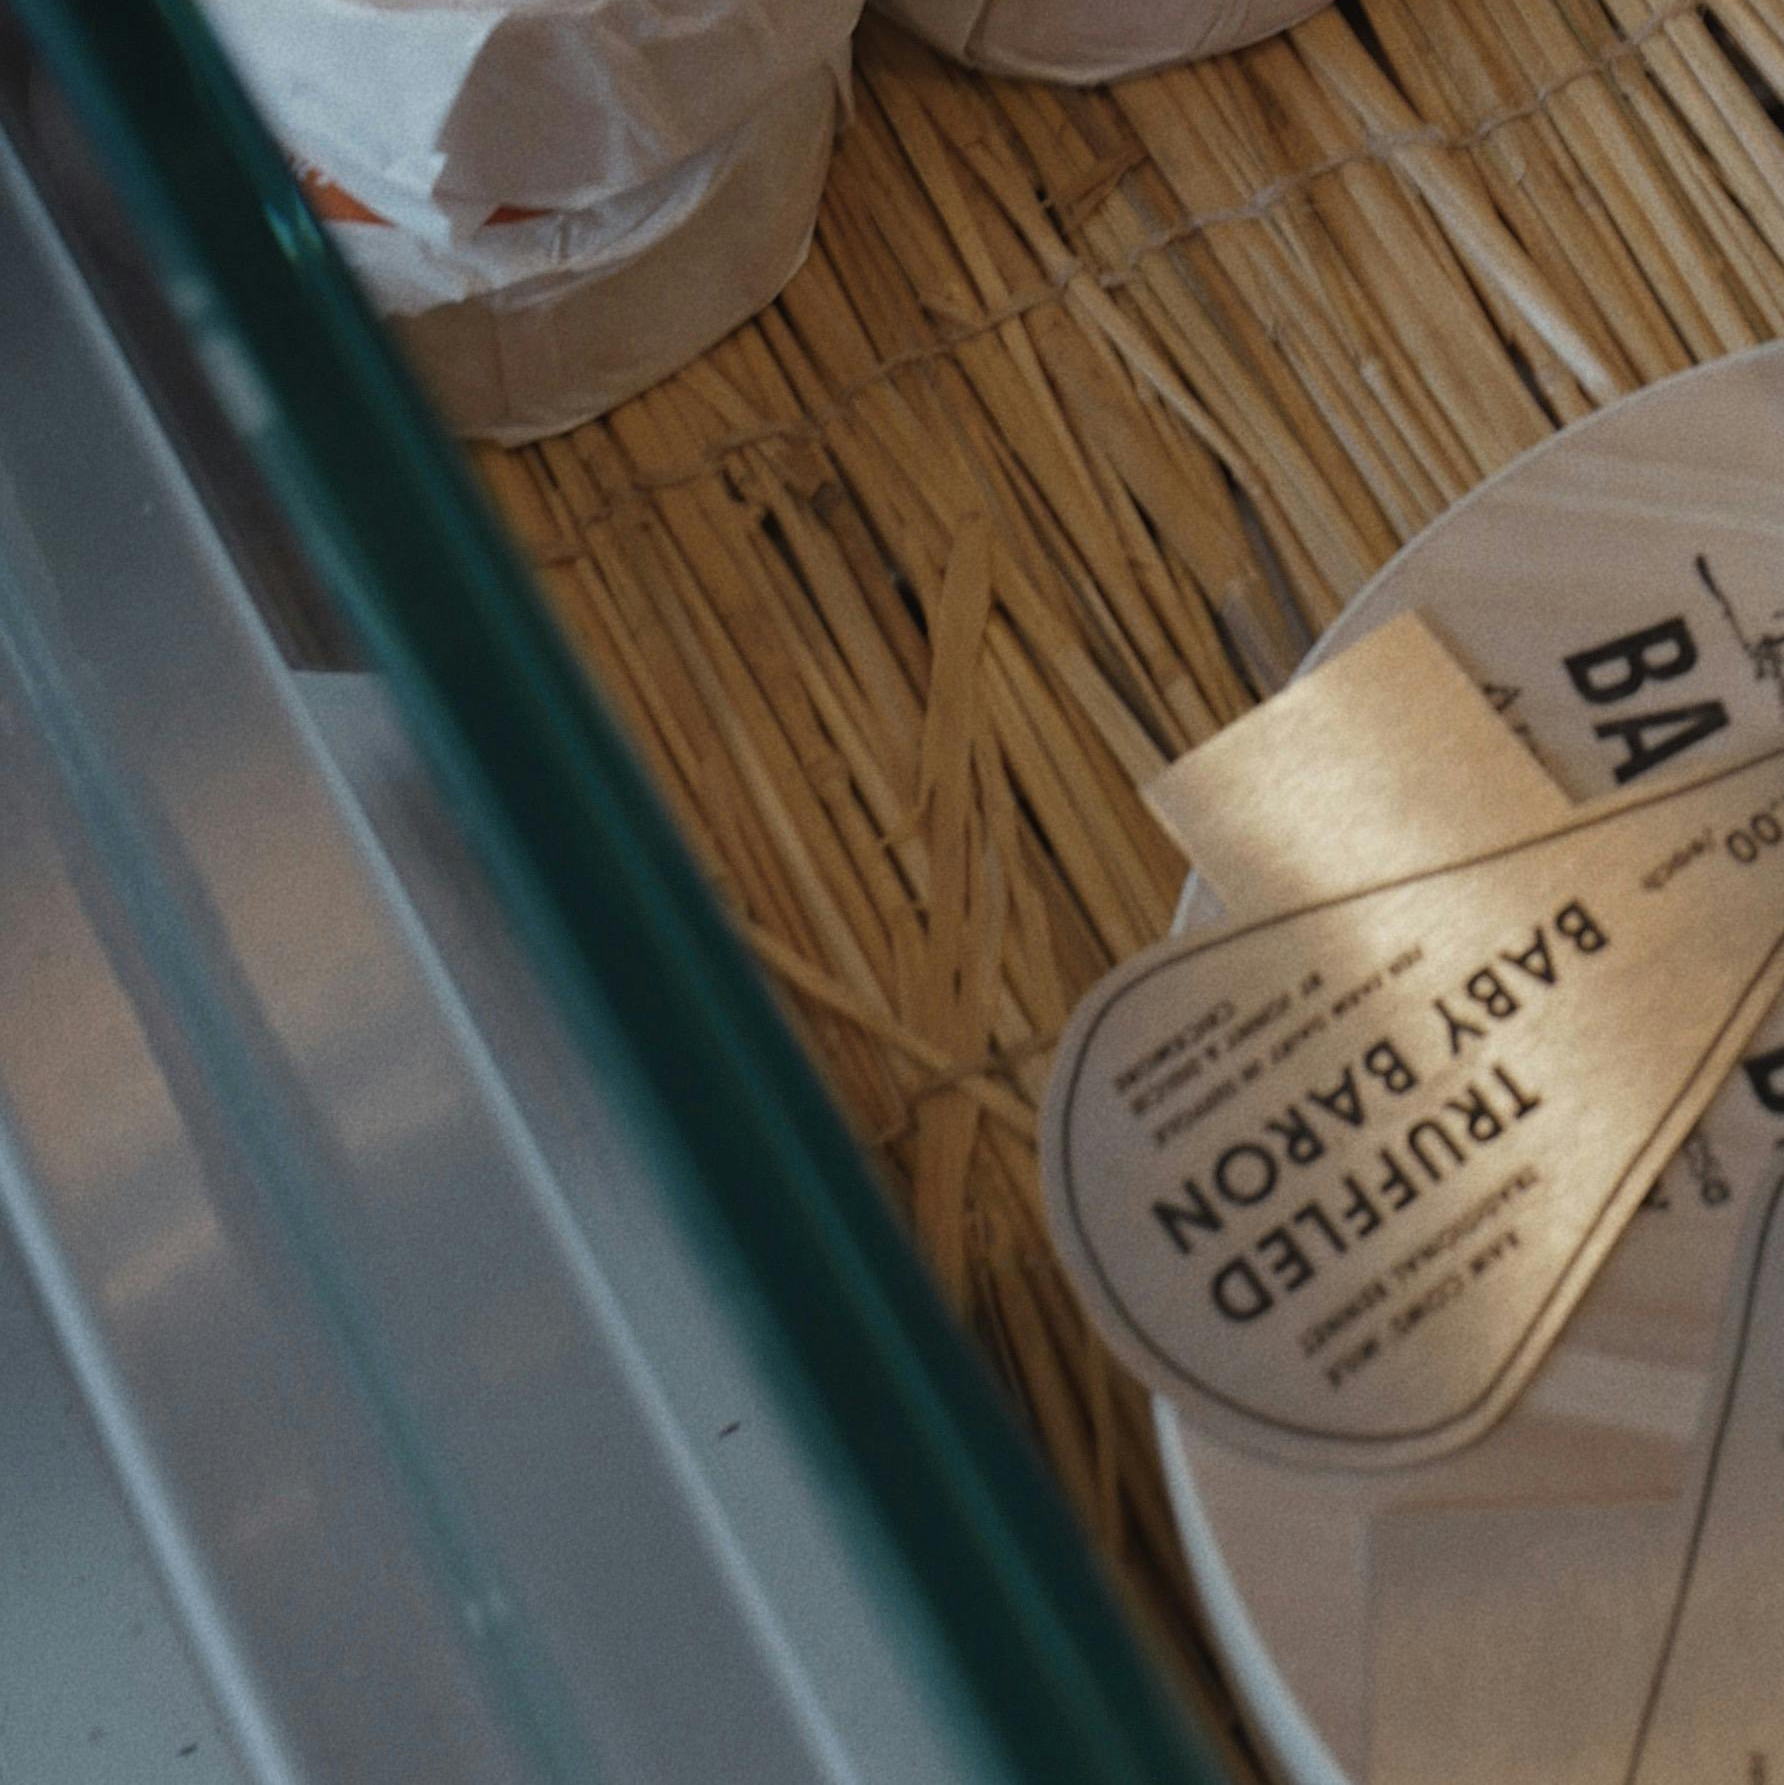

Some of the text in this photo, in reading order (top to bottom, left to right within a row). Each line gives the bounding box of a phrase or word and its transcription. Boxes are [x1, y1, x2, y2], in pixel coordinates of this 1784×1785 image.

[1150, 898, 1612, 1257] BABY BARON
[1209, 1059, 1543, 1326] TRUFFLED
